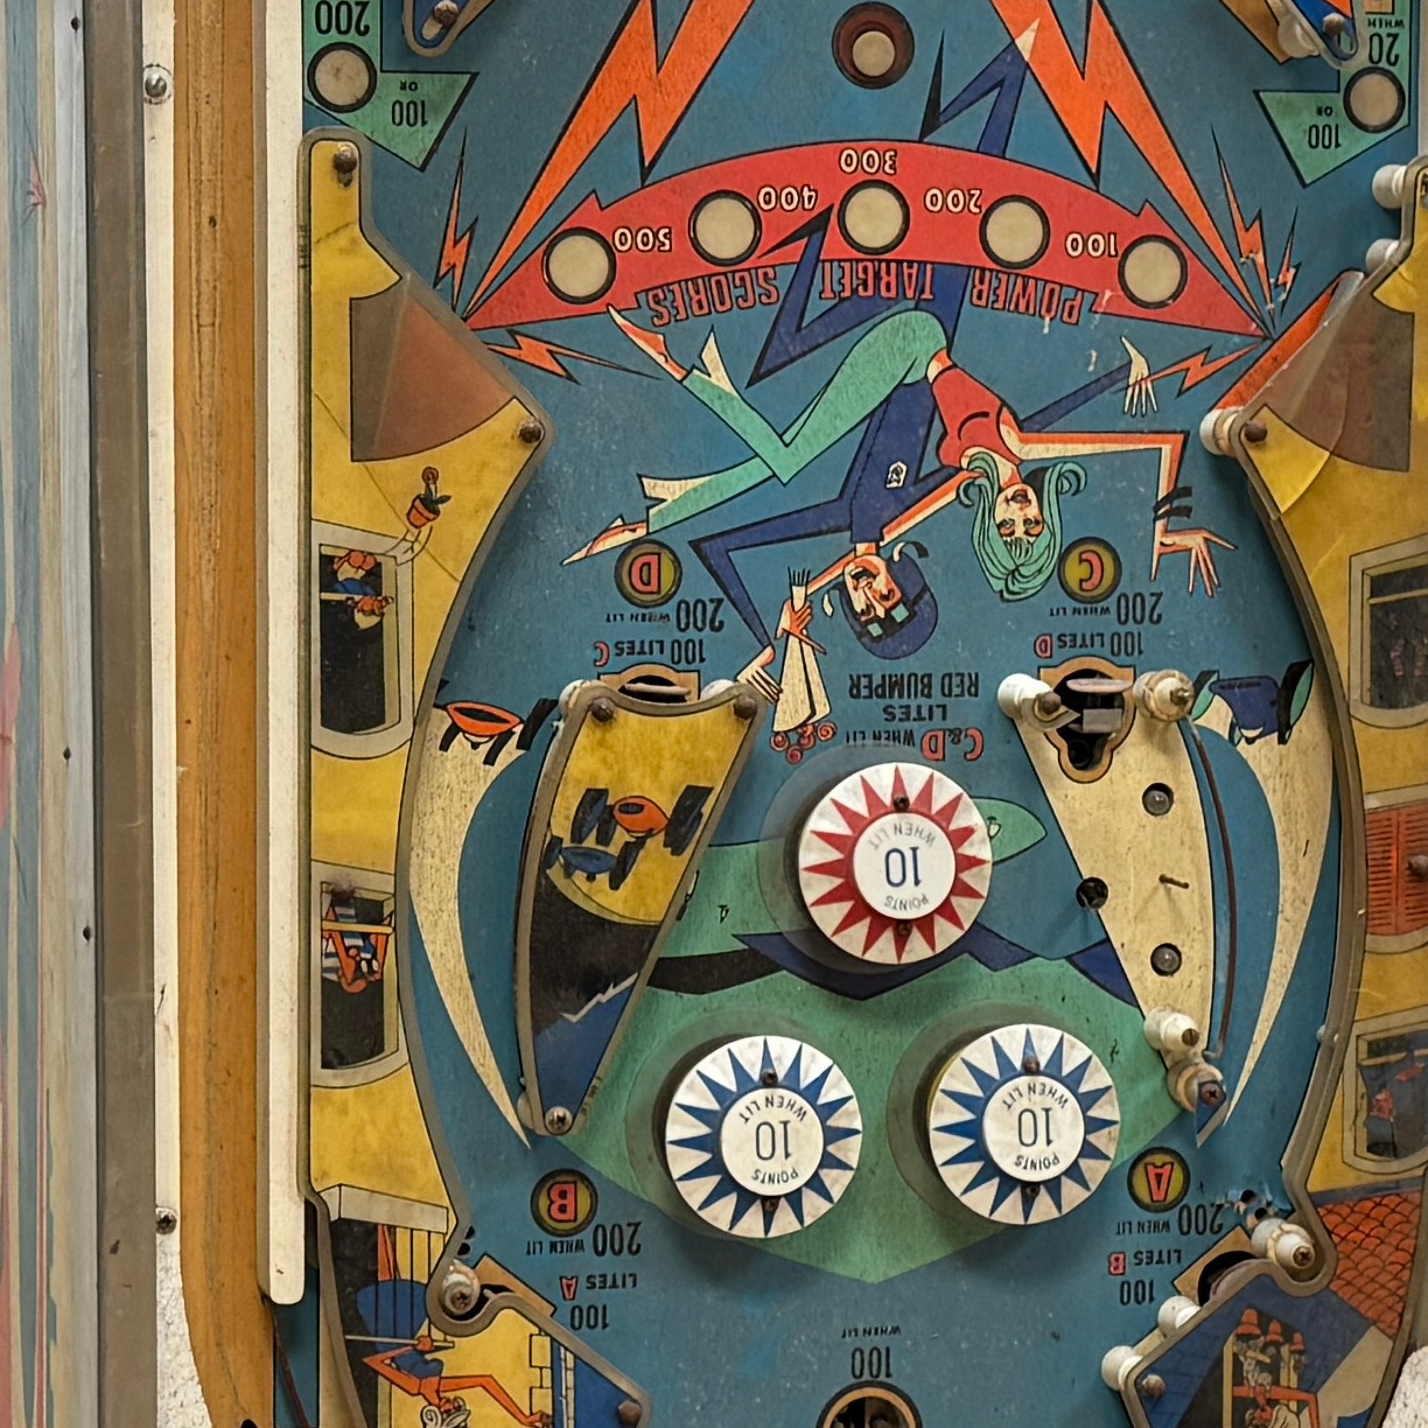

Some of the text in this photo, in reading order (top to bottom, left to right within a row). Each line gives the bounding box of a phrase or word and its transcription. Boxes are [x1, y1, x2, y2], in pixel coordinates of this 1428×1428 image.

[315, 0, 370, 37] 200
[1367, 18, 1405, 29] WHEN
[400, 80, 418, 91] OR
[392, 100, 428, 127] 100
[1308, 124, 1342, 149] 100
[839, 148, 898, 175] 300
[757, 185, 818, 212] 400
[924, 187, 982, 214] 200
[613, 226, 672, 253] 500
[1065, 232, 1119, 259] 100
[646, 258, 1086, 328] POWER TARGET SCORES
[629, 552, 661, 595] D
[1079, 549, 1104, 592] C
[606, 598, 725, 633] 200 WHEN LIT
[1049, 591, 1163, 625] 200 WHEN LIT
[594, 638, 706, 668] 100 LITES C
[1033, 631, 1143, 659] 100 LITES D
[848, 672, 979, 700] RED BUMPER
[882, 704, 947, 722] LITES
[872, 729, 916, 747] WHEN
[868, 823, 936, 851] WHEN LIT
[885, 846, 922, 888] 10
[884, 893, 929, 911] POINTS
[739, 1095, 808, 1124] WHEN LIT
[1002, 1082, 1069, 1111] WHEN LIT
[755, 1120, 792, 1161] 10
[1017, 1107, 1054, 1148] 10
[1014, 1152, 1060, 1171] POINTS
[752, 1168, 799, 1185] POINTS
[1145, 1161, 1174, 1203] A
[548, 1180, 577, 1223] B
[1116, 1203, 1224, 1236] 200 WHEN LIT
[526, 1221, 642, 1257] 200 WHEN LIT
[1108, 1249, 1182, 1276] LITES B
[559, 1273, 637, 1301] LITES A
[1120, 1279, 1155, 1306] 100
[570, 1304, 609, 1331] 100
[841, 1325, 901, 1339] WHEN LIT
[851, 1346, 893, 1379] 100
